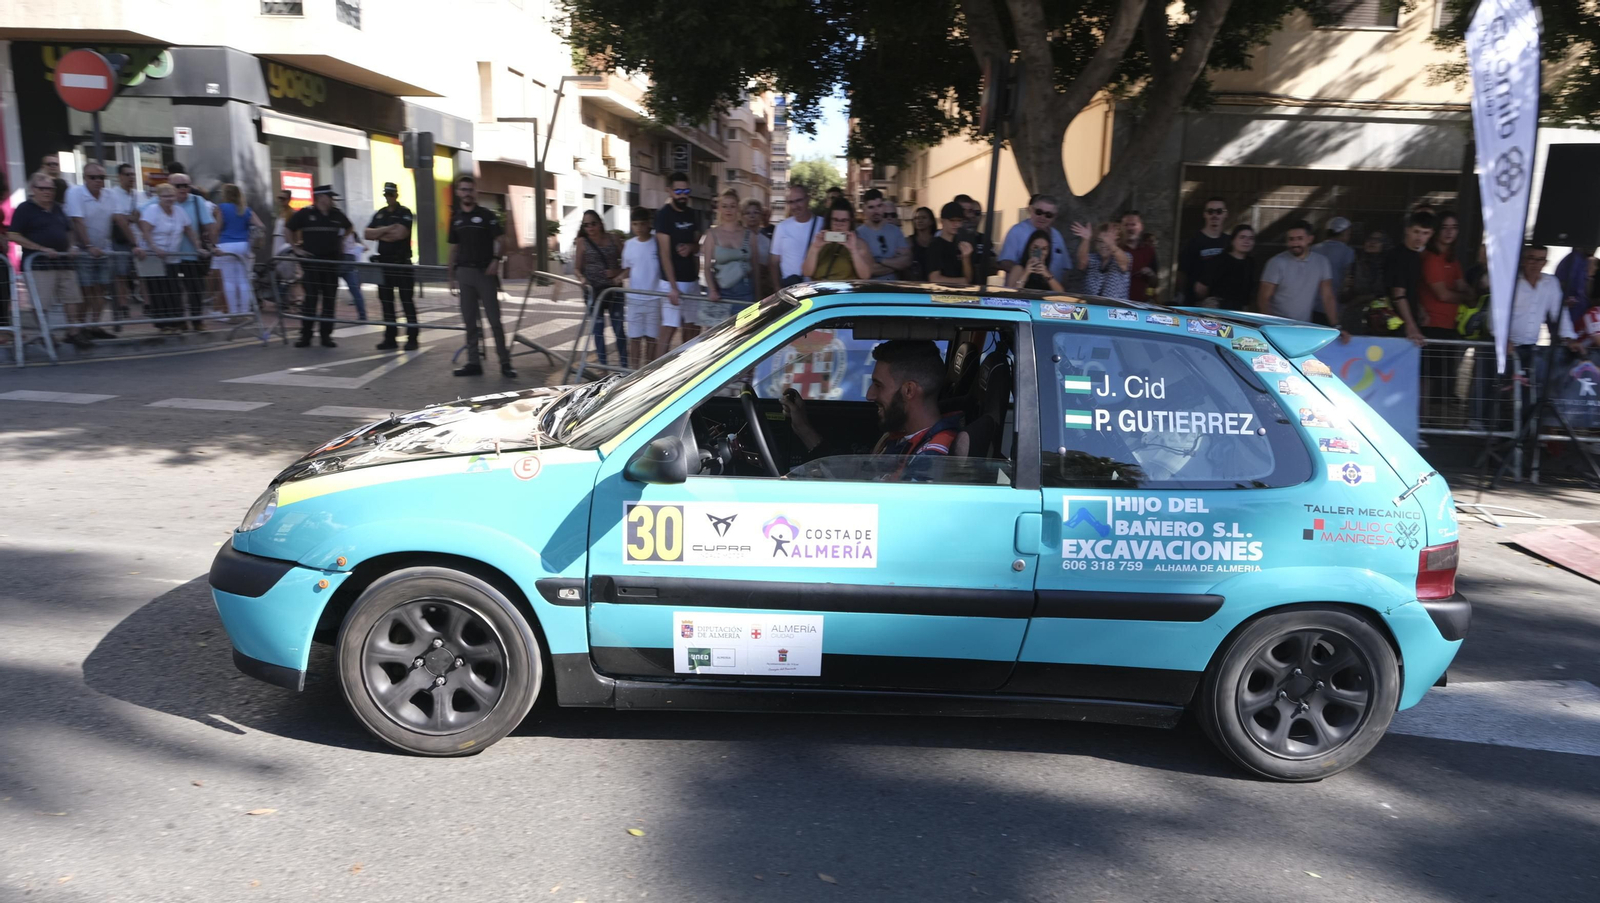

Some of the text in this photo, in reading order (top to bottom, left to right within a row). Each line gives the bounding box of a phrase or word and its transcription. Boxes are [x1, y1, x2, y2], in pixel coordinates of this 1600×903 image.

[267, 62, 327, 107] yoigo
[1096, 374, 1165, 399] J. Cid
[1094, 408, 1254, 435] P. GUTIERREZ
[522, 458, 532, 471] E
[1115, 496, 1209, 515] HIJO DEL
[1303, 503, 1421, 520] TALLER MECANICO
[627, 505, 683, 561] 30
[805, 529, 872, 540] COSTA DE
[1114, 517, 1253, 538] BAÑERO S.L.
[1339, 520, 1381, 533] JULIO
[1320, 532, 1396, 546] MANRESA
[791, 541, 873, 559] ALMERÍA
[1062, 539, 1263, 561] EXCAVACIONES
[1062, 560, 1143, 572] 606 318 759
[1154, 564, 1263, 573] ALHAMA DE ALMERIA
[697, 625, 743, 633] DIPUTACIÓN
[771, 624, 817, 633] ALMERÍA
